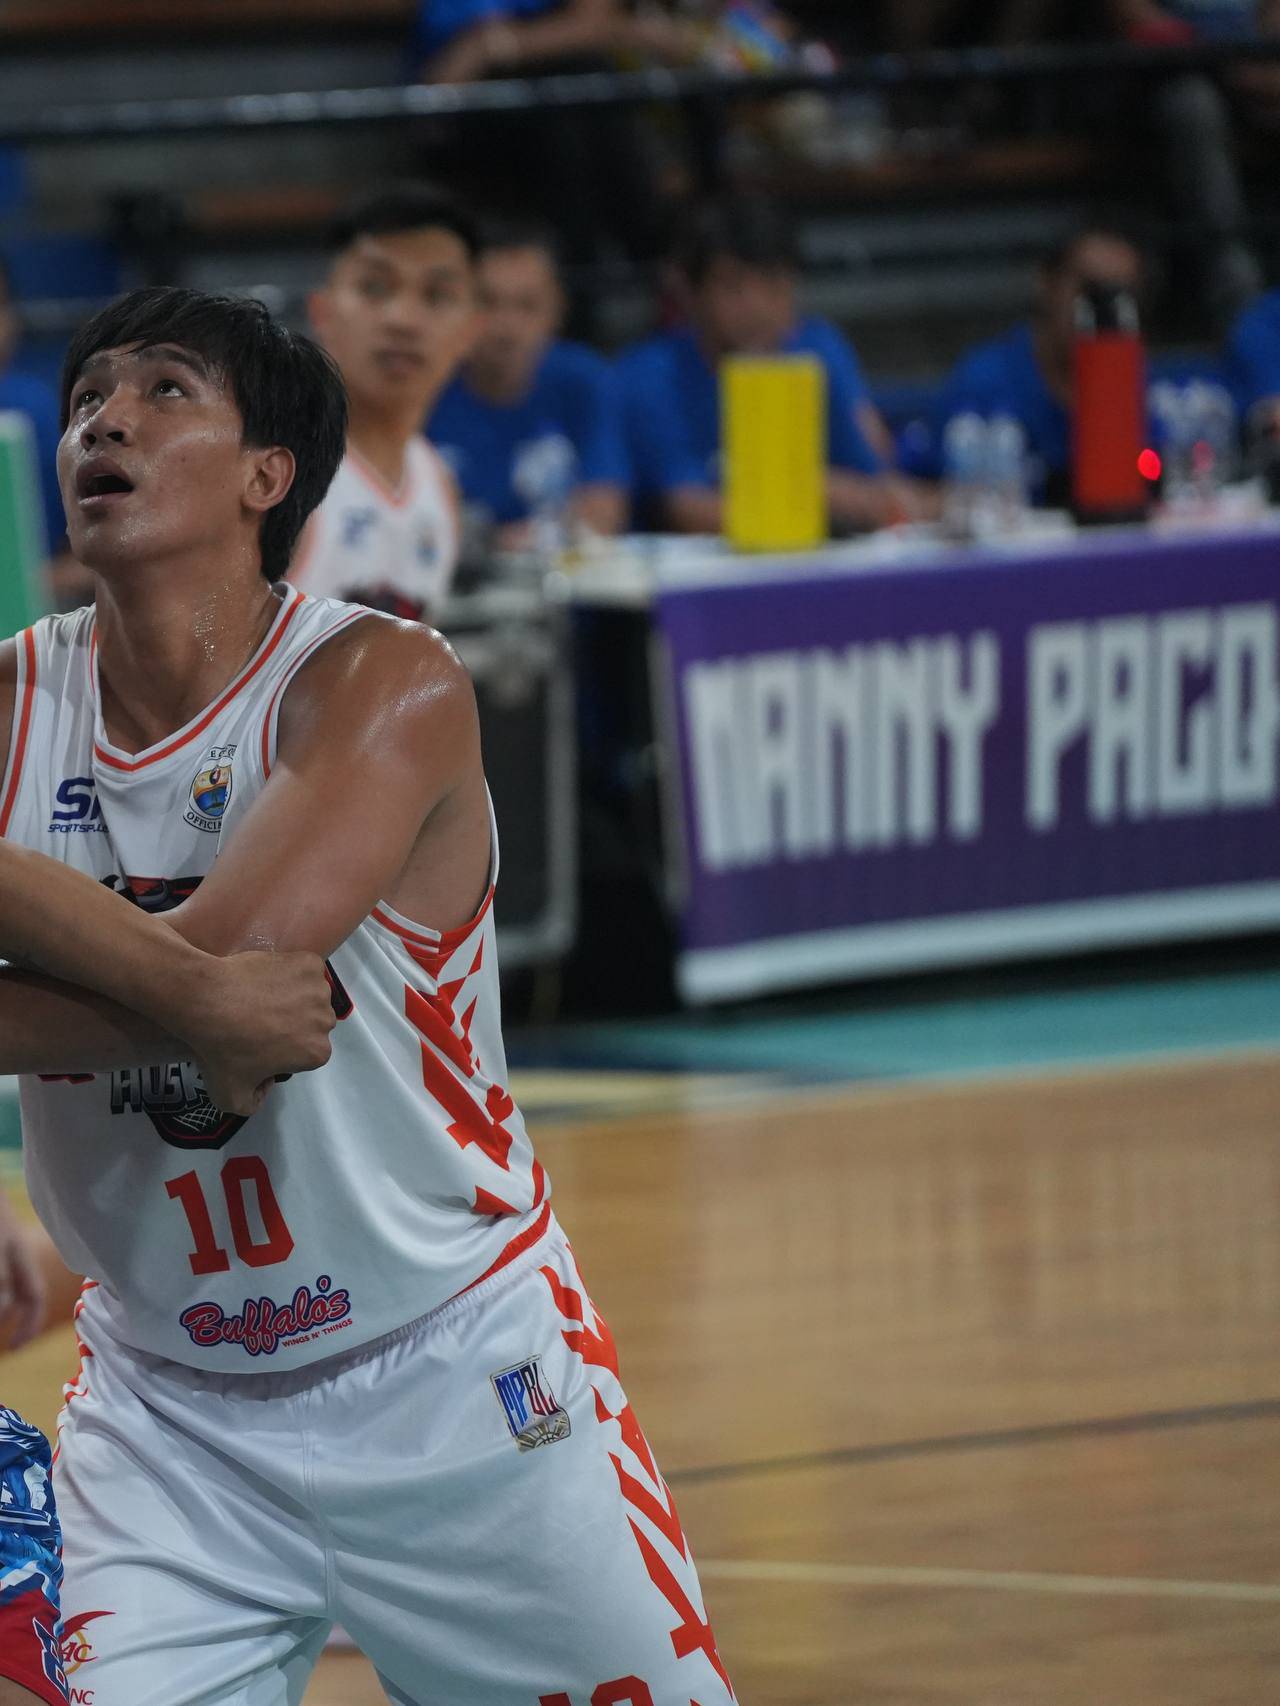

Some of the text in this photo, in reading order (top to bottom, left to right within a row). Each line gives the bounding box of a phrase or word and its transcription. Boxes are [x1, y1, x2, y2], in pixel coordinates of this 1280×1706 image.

[685, 632, 1001, 872] MANNY
[111, 1062, 208, 1115] HUSK
[165, 1156, 294, 1275] 10
[282, 1335, 310, 1347] WINGS
[322, 1318, 353, 1335] THINGS
[494, 1361, 561, 1437] MPBL
